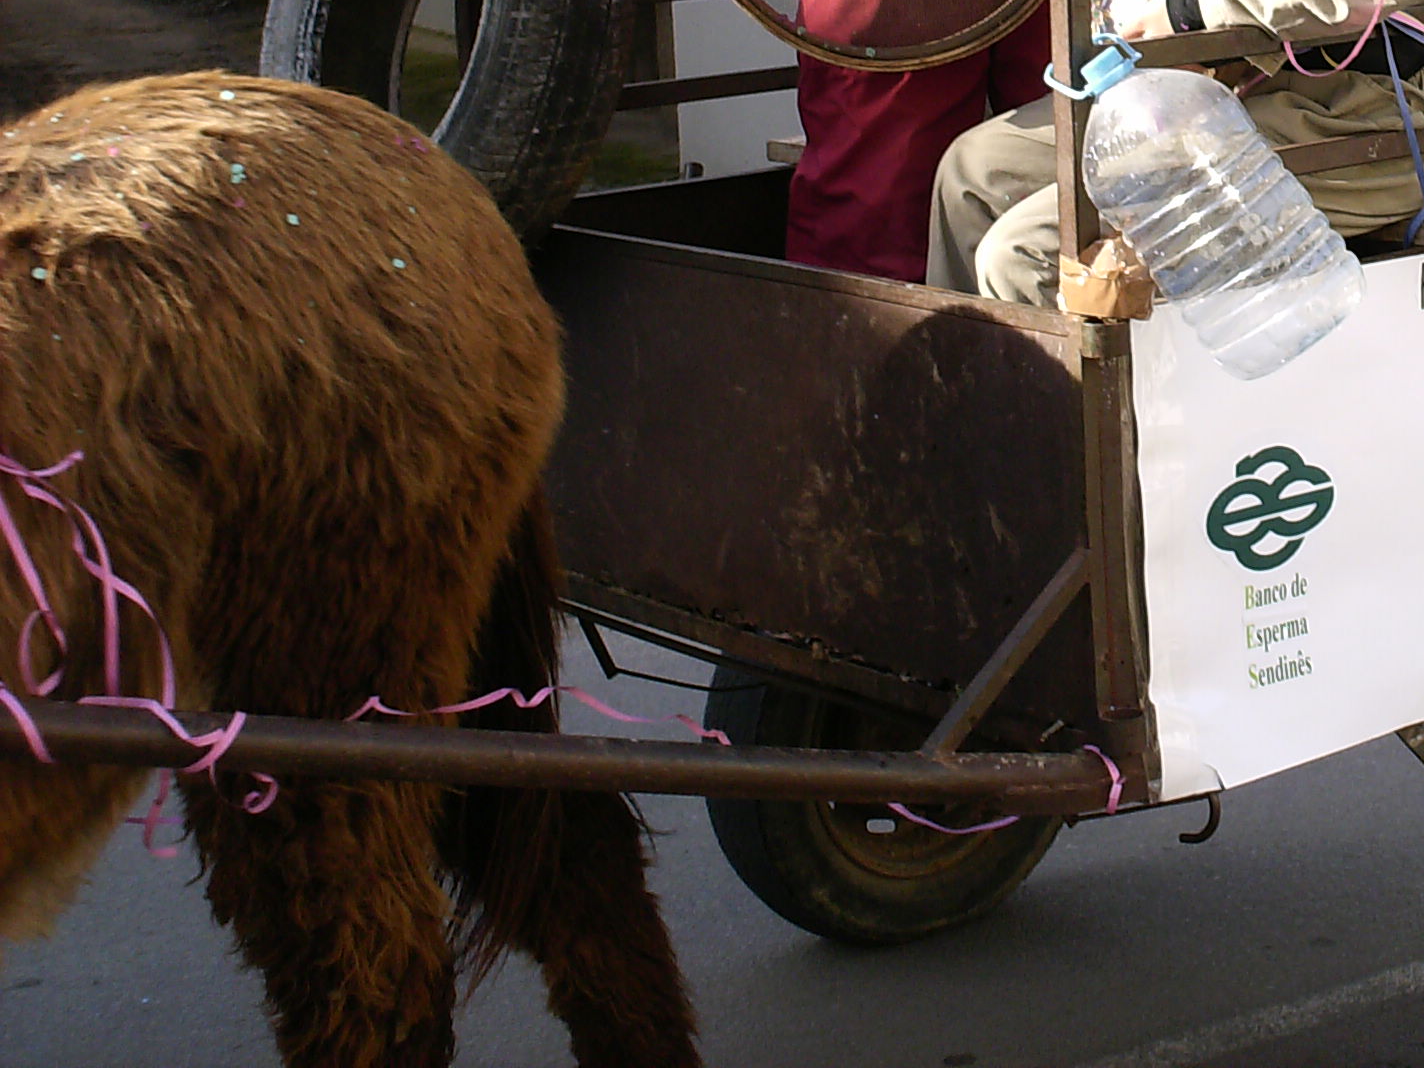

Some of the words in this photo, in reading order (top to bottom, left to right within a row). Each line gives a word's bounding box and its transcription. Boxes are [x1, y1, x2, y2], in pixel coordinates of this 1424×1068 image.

[1244, 583, 1287, 610] Banco
[1290, 571, 1308, 599] de
[1245, 616, 1309, 653] Esperma
[1248, 649, 1313, 690] Sendinês
